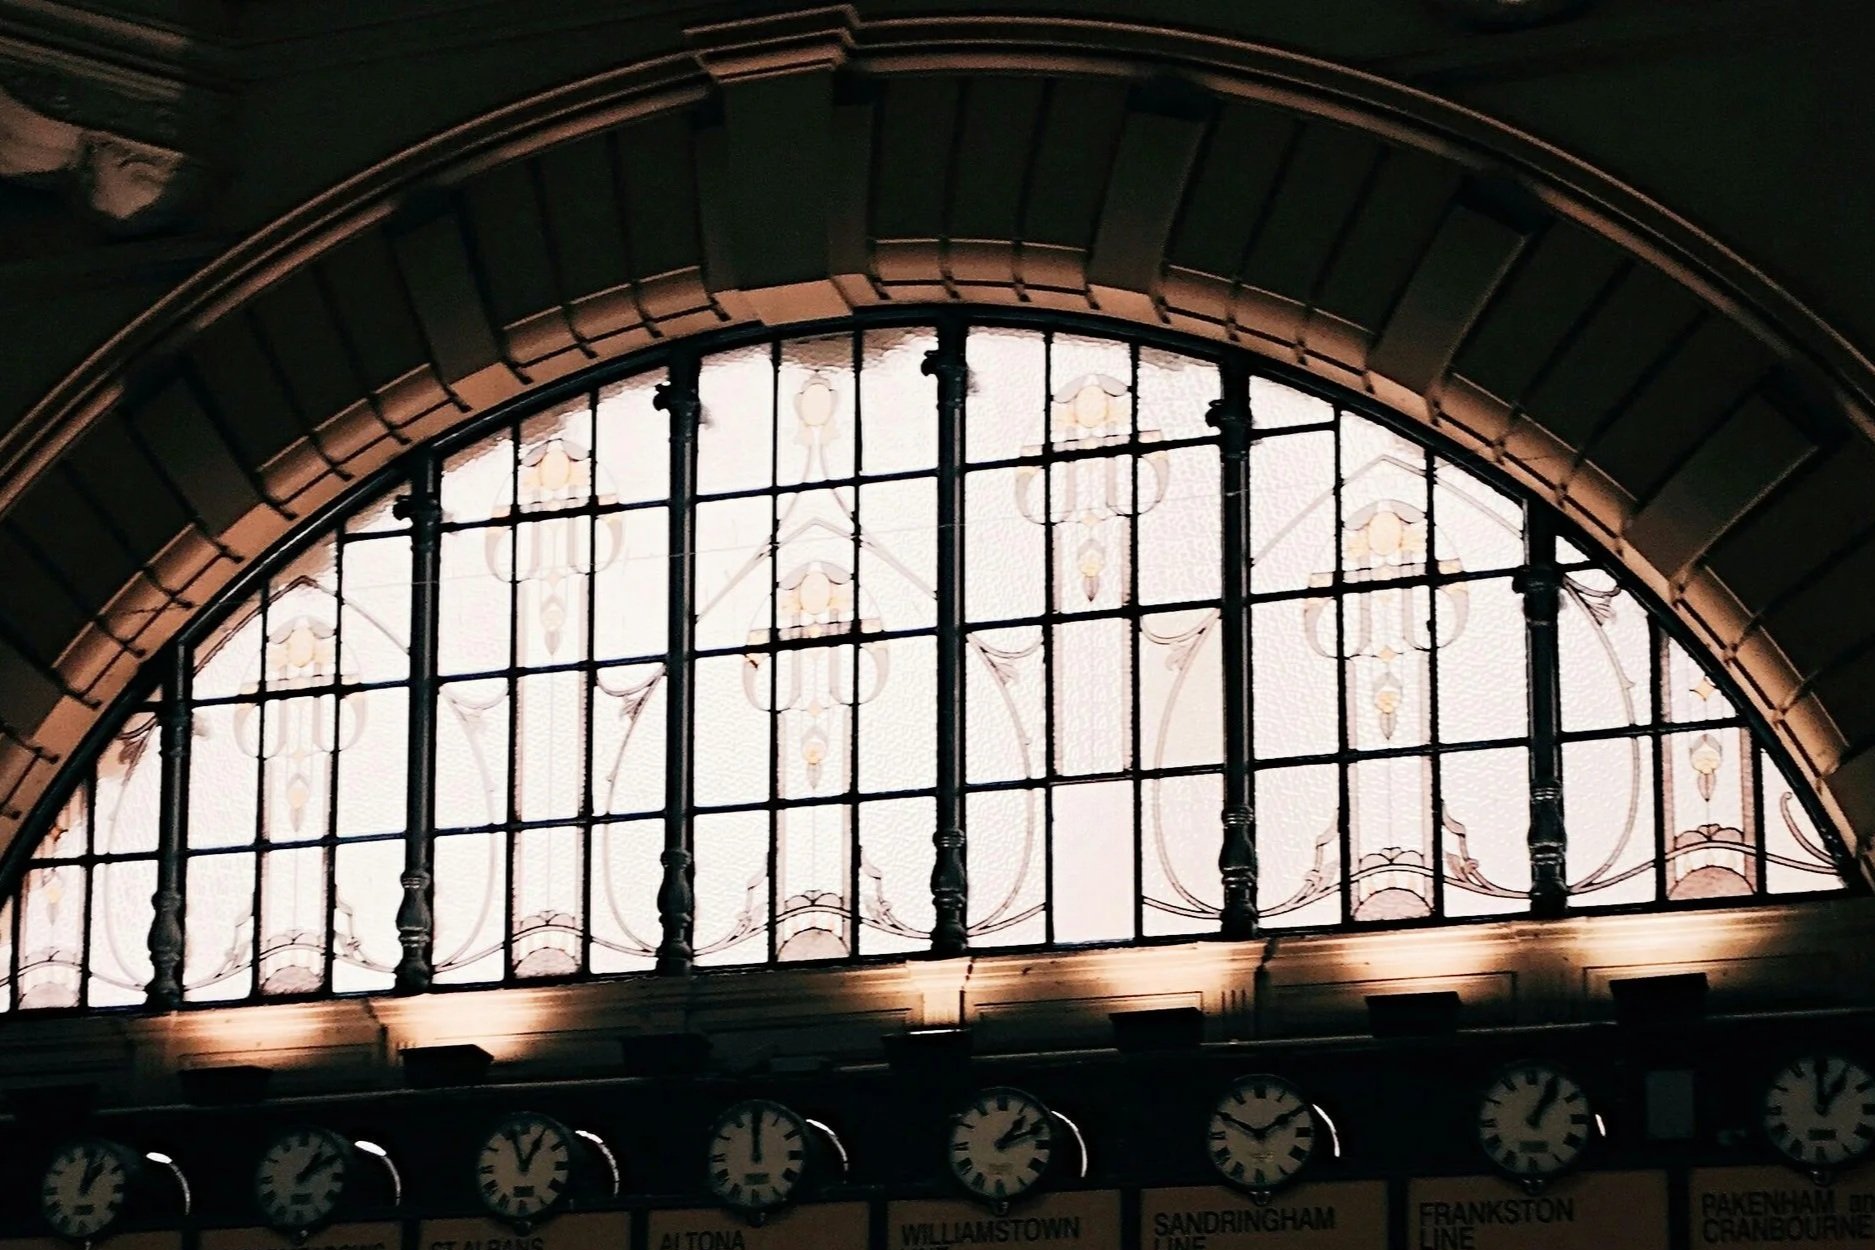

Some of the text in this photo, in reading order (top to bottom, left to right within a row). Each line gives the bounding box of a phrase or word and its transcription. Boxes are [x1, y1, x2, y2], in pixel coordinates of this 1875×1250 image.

[1419, 1197, 1575, 1226] FRANKSTON
[1702, 1189, 1875, 1216] PAKENHAM an
[900, 1216, 1081, 1246] WILLIAMSTOWN
[1153, 1206, 1336, 1237] SANDRINGHAM
[1702, 1214, 1874, 1243] CRANBOURNE
